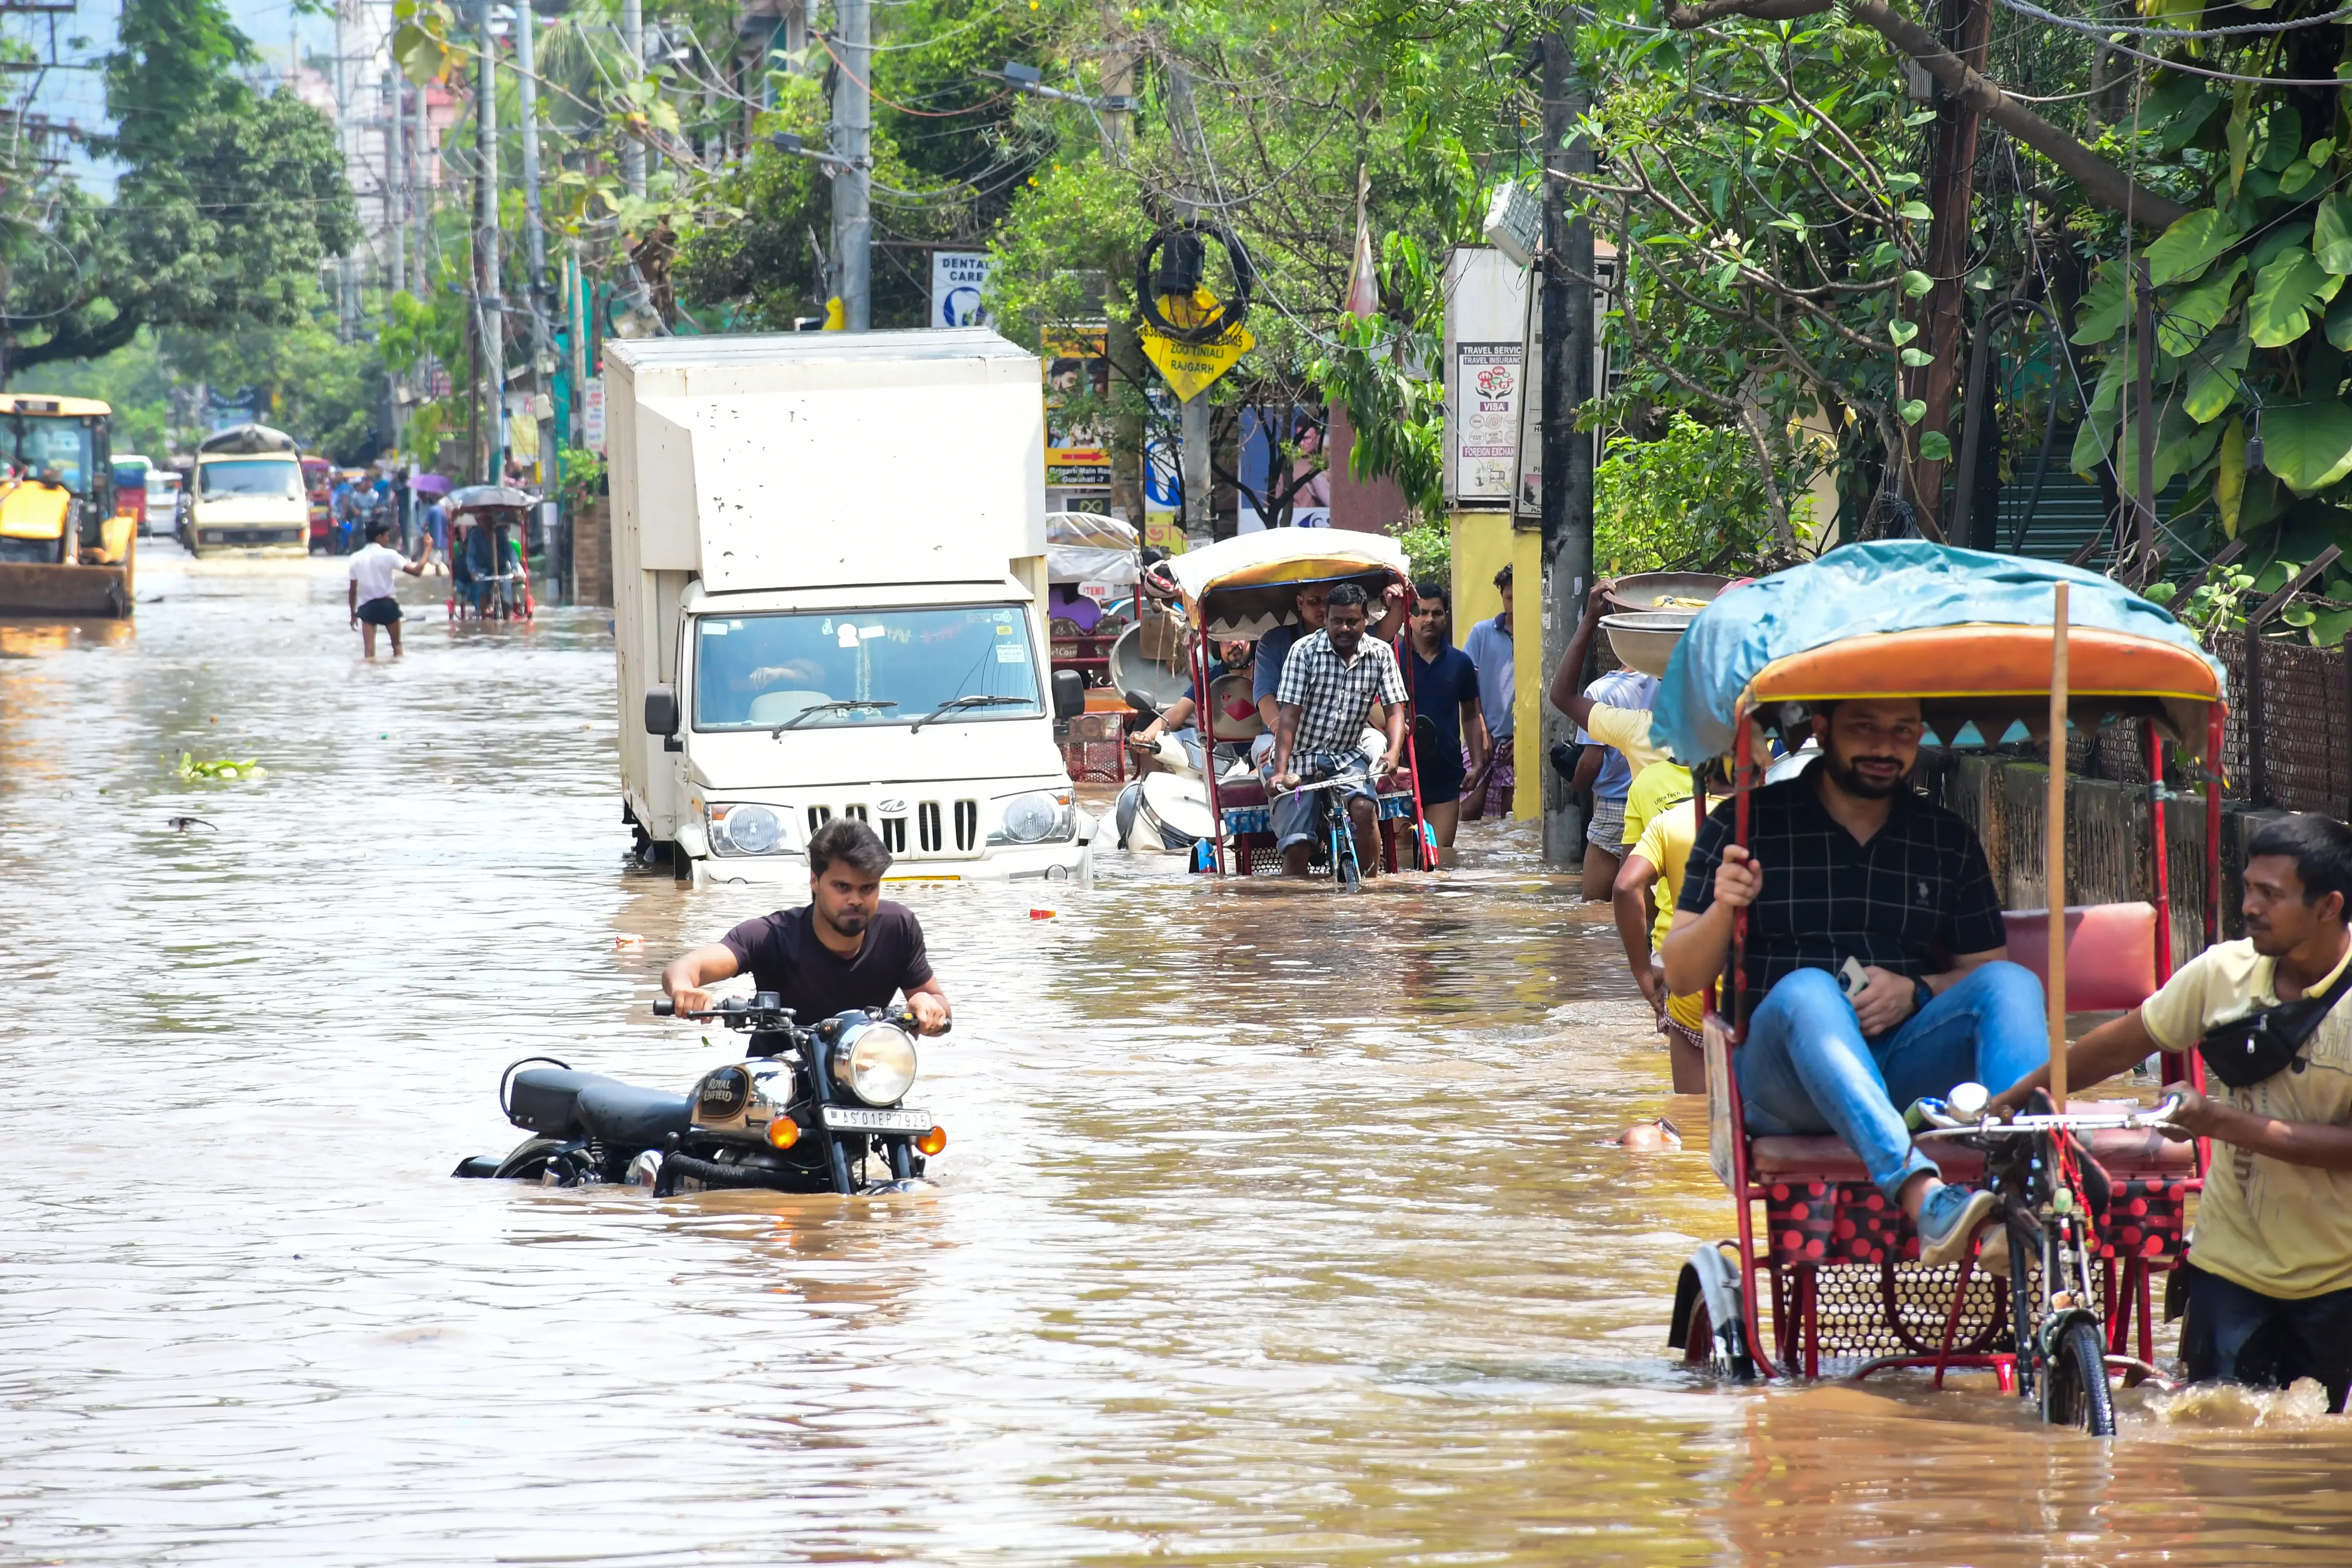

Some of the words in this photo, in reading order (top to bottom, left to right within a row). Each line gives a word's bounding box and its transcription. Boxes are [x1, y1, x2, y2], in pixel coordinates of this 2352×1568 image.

[943, 259, 991, 269] DENTAL
[950, 271, 983, 281] CARE
[1171, 344, 1189, 355] ZOO
[1192, 346, 1224, 358] TINIALI
[1463, 346, 1492, 354] TRAVEL
[1171, 360, 1215, 374] RAJGARH
[1484, 403, 1505, 411] VISA
[1464, 447, 1490, 456] FOREIGN
[708, 1078, 731, 1089] ROYAL
[704, 1090, 732, 1102] ENFIELD
